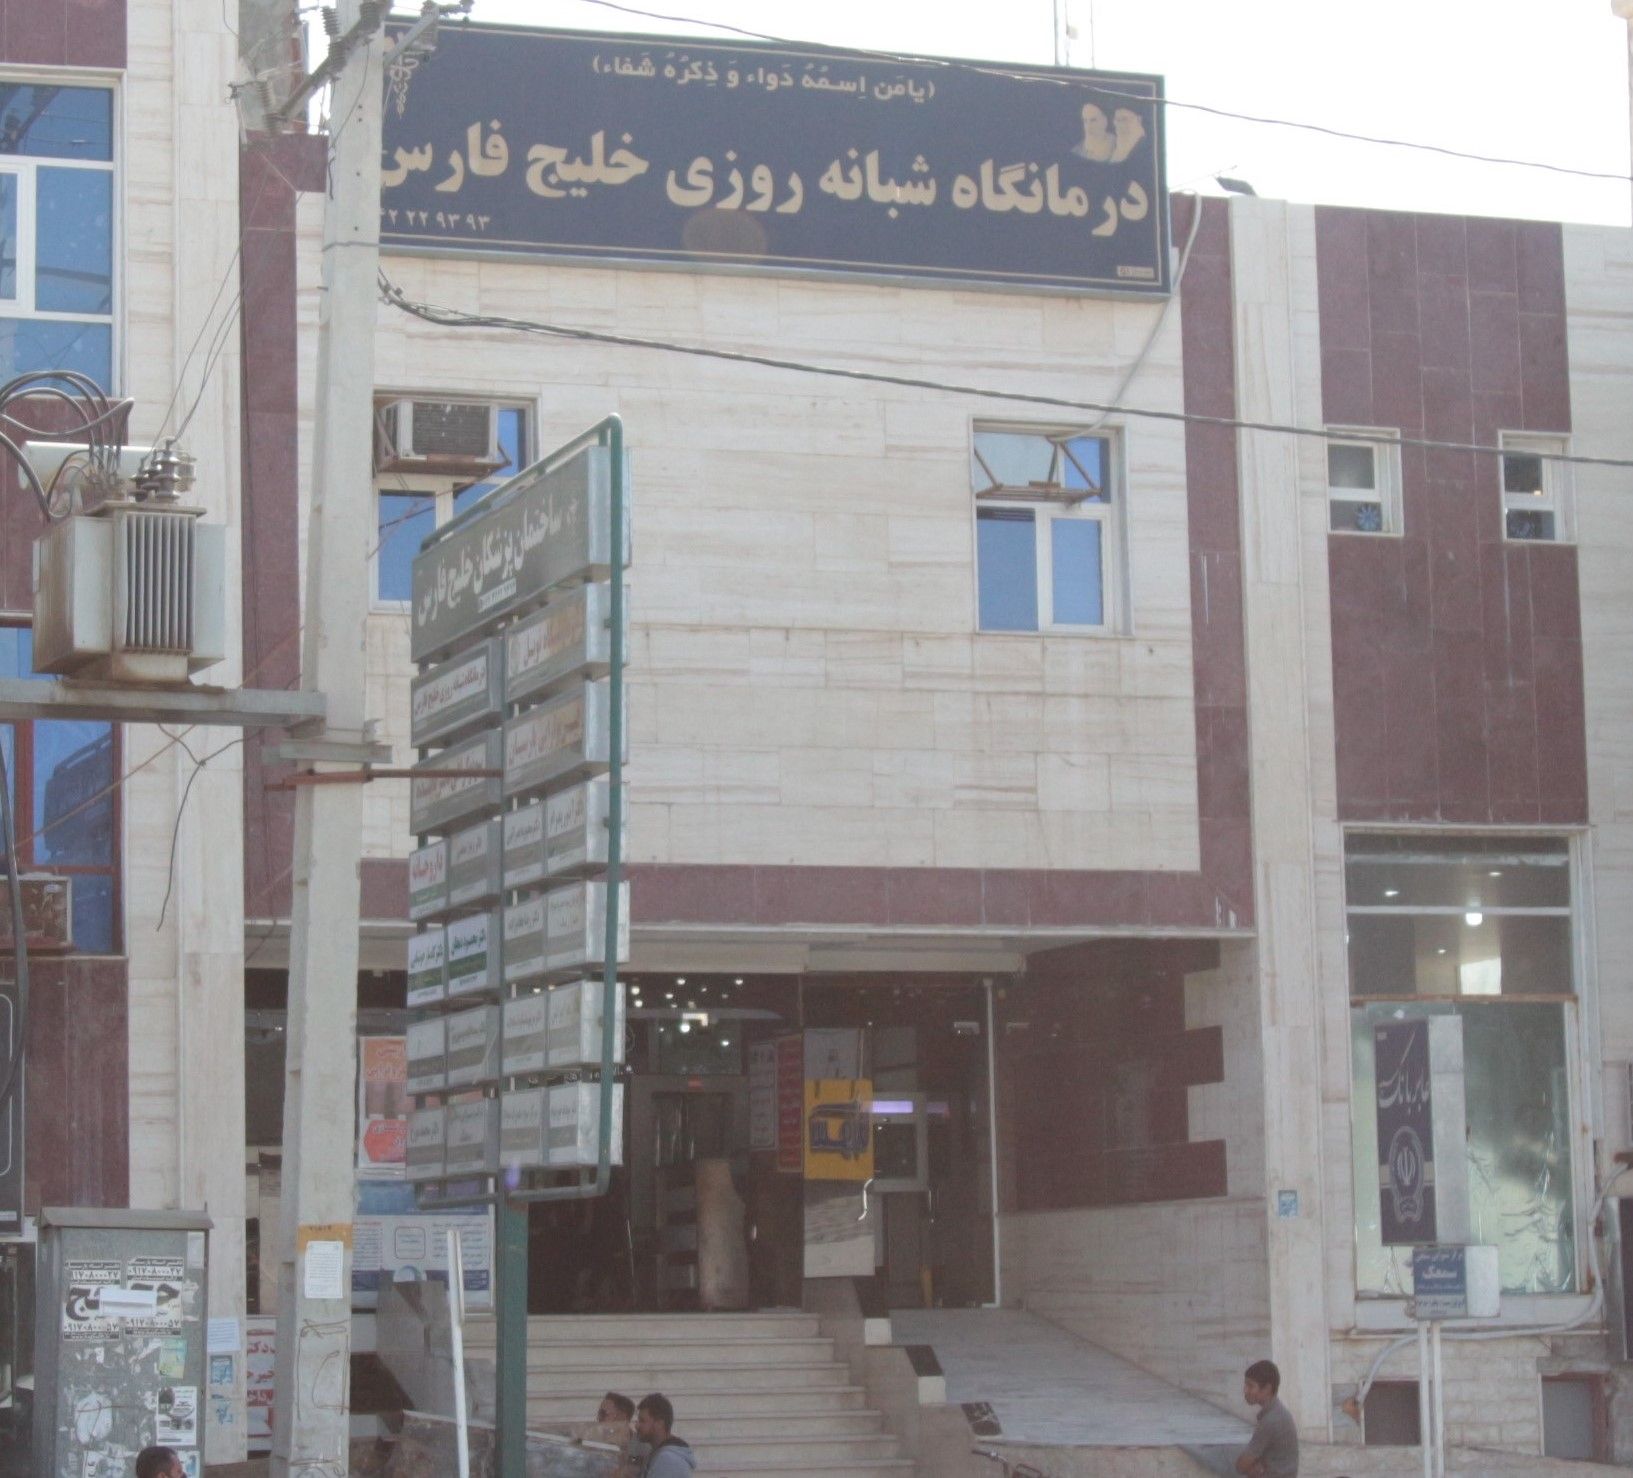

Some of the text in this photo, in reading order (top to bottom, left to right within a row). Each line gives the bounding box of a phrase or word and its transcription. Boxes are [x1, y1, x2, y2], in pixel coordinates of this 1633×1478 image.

[381, 119, 1149, 237] درمانگاه شبانه روزی خلیج فارس
